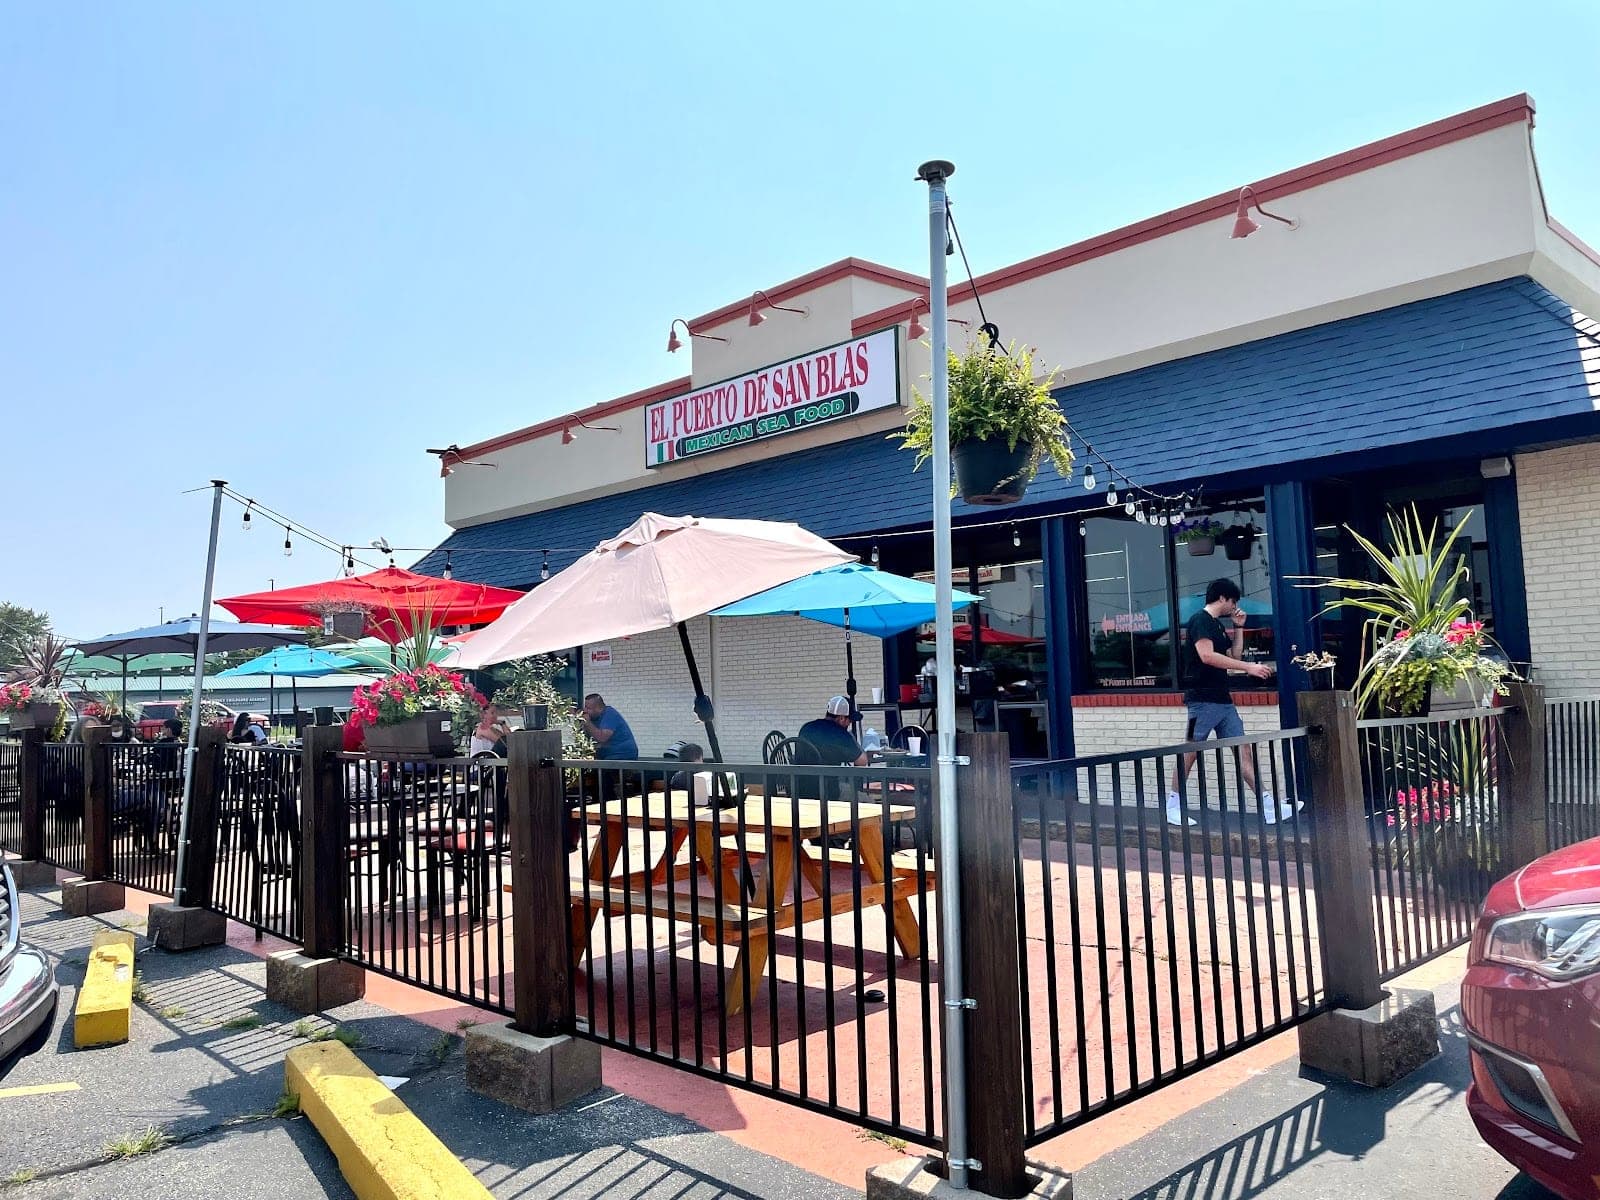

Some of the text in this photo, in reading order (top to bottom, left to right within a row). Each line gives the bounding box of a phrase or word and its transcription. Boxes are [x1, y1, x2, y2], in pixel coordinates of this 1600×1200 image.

[651, 342, 869, 443] EL PUERTO DE SAN BLAS
[685, 398, 845, 453] MEXICAN SEA FOOD
[1115, 613, 1149, 623] ENTRADA
[1115, 622, 1152, 633] ENTRANCE
